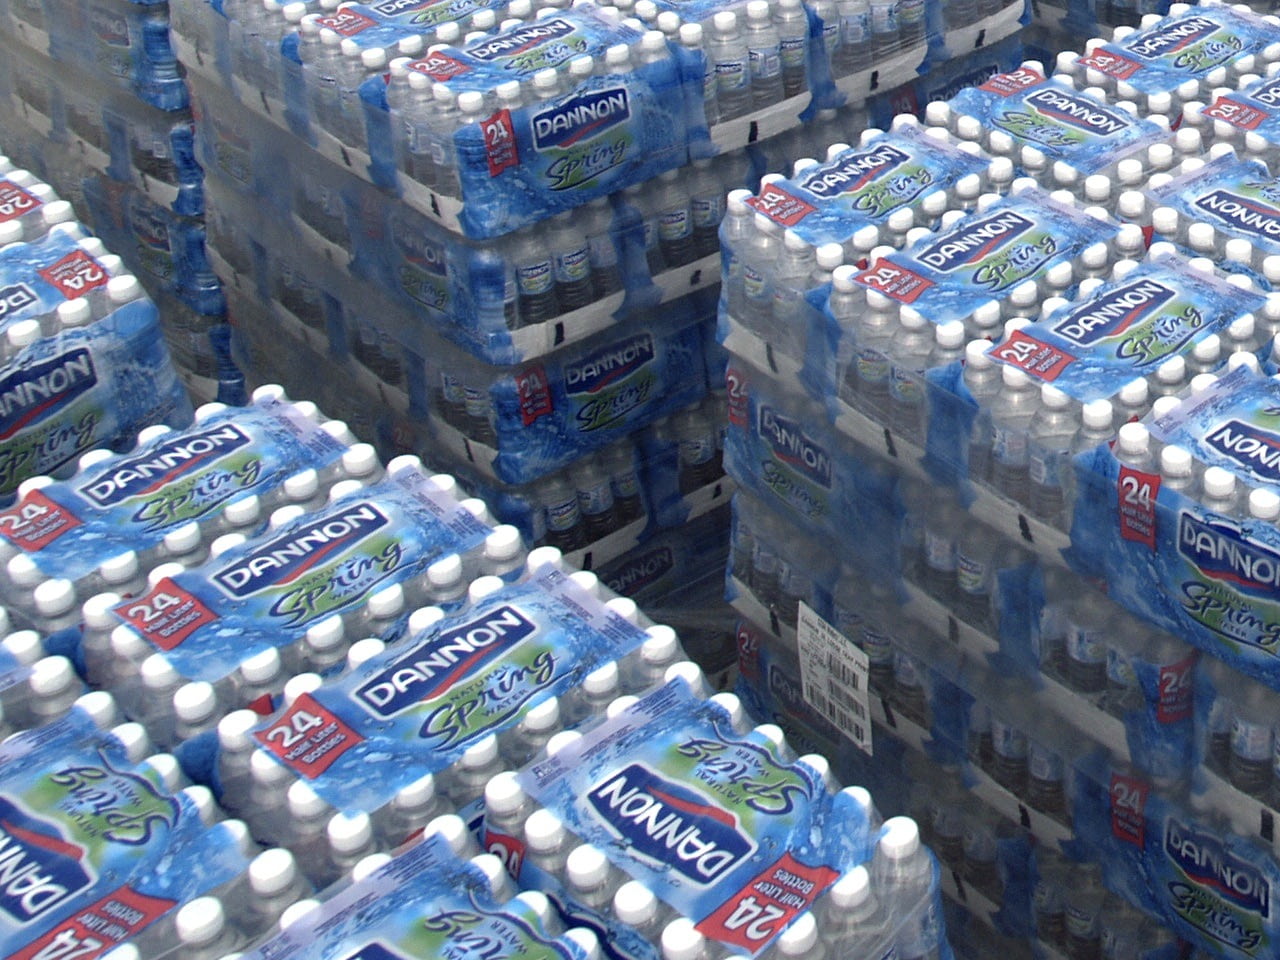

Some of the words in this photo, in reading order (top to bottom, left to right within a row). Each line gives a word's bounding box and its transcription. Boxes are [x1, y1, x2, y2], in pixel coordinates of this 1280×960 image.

[328, 12, 356, 29] 24
[472, 19, 574, 61] DANNON
[1126, 16, 1216, 58] DANNON
[417, 54, 448, 75] 24
[1006, 70, 1035, 85] 24
[535, 93, 628, 140] DANNON
[1036, 92, 1124, 134] DANNON
[1211, 100, 1239, 119] 24
[488, 115, 509, 147] 24
[546, 137, 627, 190] Spring
[808, 146, 901, 193] DANNON
[852, 168, 933, 216] Spring
[924, 214, 1024, 266] DANNON
[63, 268, 103, 290] 24
[865, 267, 902, 286] 24
[971, 236, 1059, 290] Spring
[1061, 280, 1166, 340] DANNON
[1001, 340, 1039, 362] 24
[1115, 305, 1205, 366] Spring
[566, 338, 652, 386] DANNON
[517, 370, 543, 400] 24
[576, 375, 652, 431] Spring
[88, 426, 241, 500] DANNON
[131, 458, 262, 529] Spring
[1121, 475, 1151, 512] 24
[1, 502, 48, 530] 24
[222, 507, 378, 589] DANNON
[268, 542, 405, 626] Spring
[127, 591, 181, 622] 24
[363, 611, 523, 707] DANNON
[418, 650, 559, 750] Spring
[450, 663, 509, 701] NATURAL
[482, 689, 530, 718] WATER
[267, 709, 323, 749] 24
[301, 733, 347, 765] Bottles
[311, 721, 340, 746] Liter
[676, 736, 797, 816] Spring
[51, 767, 172, 846] Spring
[1113, 783, 1142, 816] 24
[598, 775, 736, 878] DANNON
[774, 868, 816, 896] Bottles
[1168, 829, 1268, 907] DANNON
[753, 879, 784, 903] Liter
[724, 896, 787, 942] 24
[1167, 880, 1264, 950] Spring
